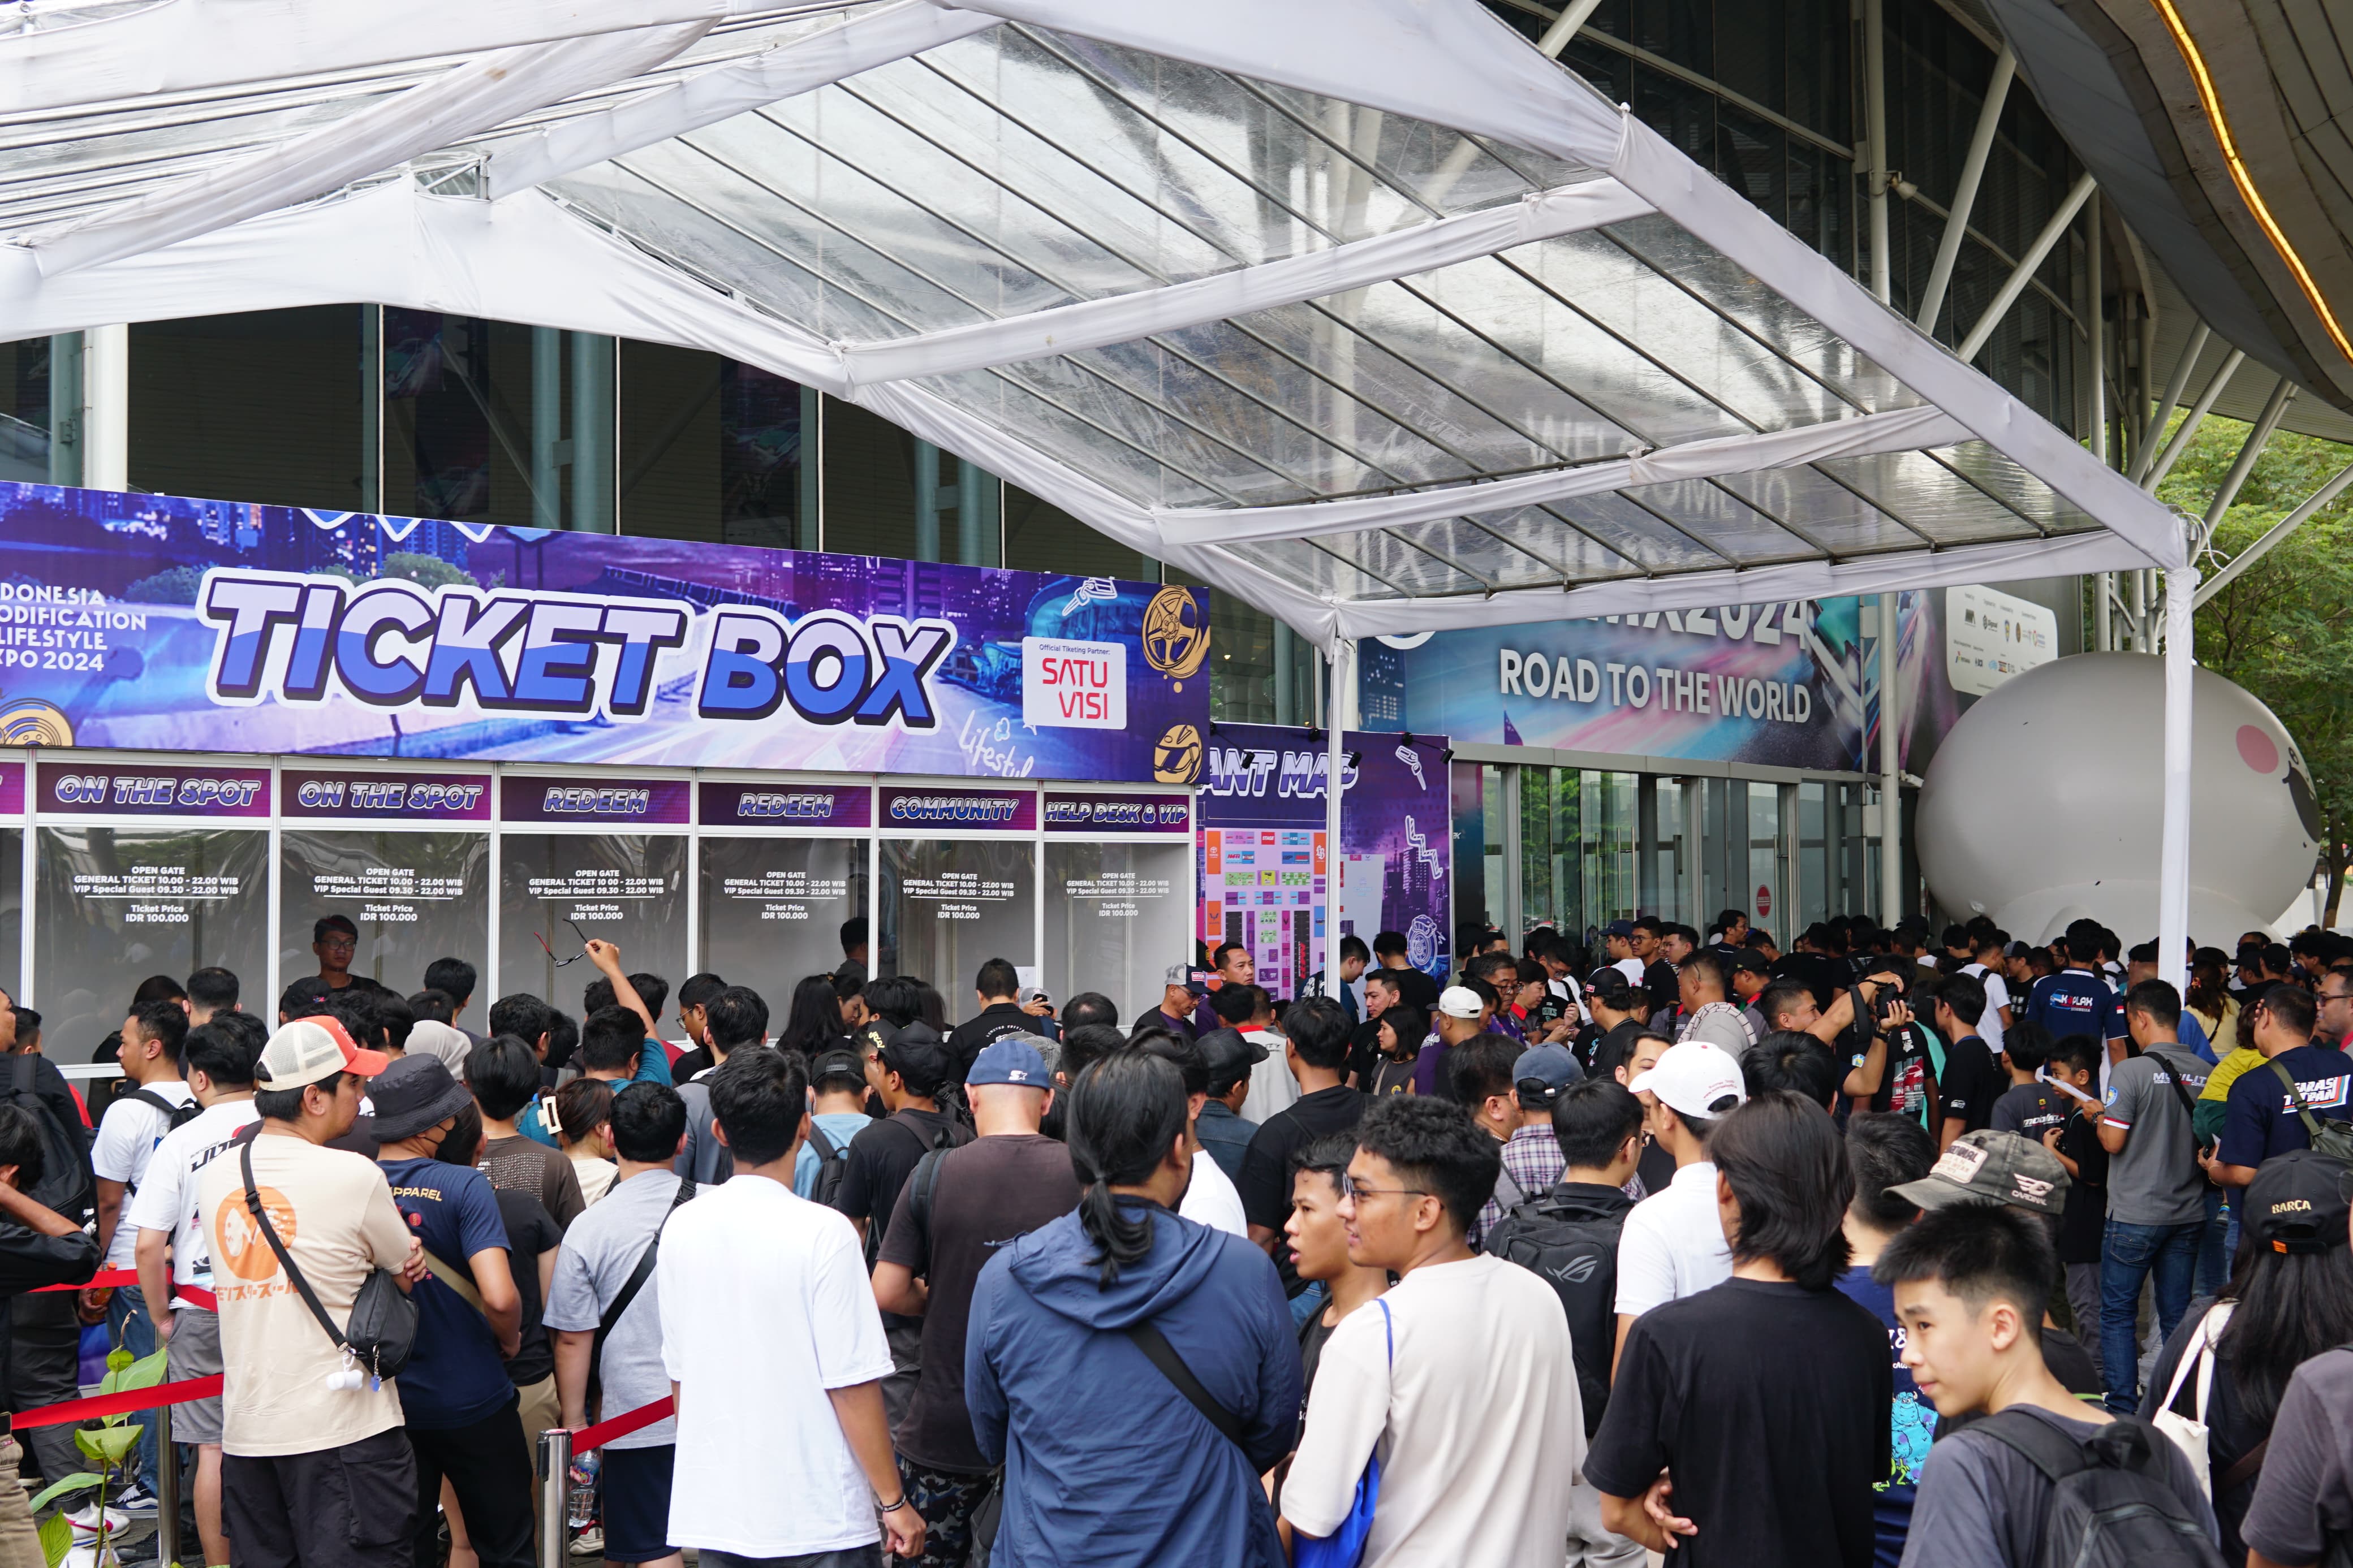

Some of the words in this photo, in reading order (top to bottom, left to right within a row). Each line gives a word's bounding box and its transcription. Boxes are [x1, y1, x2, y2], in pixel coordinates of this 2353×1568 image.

[204, 574, 689, 717] TICKET
[698, 611, 951, 729] BOX
[1039, 643, 1061, 653] Official
[1062, 645, 1086, 655] Tiketing
[1087, 646, 1110, 656] Partner:
[42, 650, 105, 672] 2024
[1042, 657, 1107, 688] SATU
[1499, 648, 1600, 705] ROAD
[1606, 662, 1650, 710] TO
[1655, 668, 1711, 715] THE
[1717, 676, 1811, 724] WORLD
[1058, 690, 1108, 720] VISI
[56, 775, 109, 804] ON
[113, 777, 177, 805] THE
[178, 778, 261, 807] SPOT
[298, 780, 346, 807] ON
[350, 781, 407, 809] THE
[407, 783, 484, 810] SPOT
[543, 787, 649, 813] REDEEM
[737, 793, 835, 818] REDEEM
[890, 796, 1019, 820] COMMUNITY
[1044, 802, 1092, 822] HELP
[1092, 802, 1143, 823] DESK
[1141, 804, 1156, 824] &
[1158, 804, 1189, 824] VIP
[92, 885, 126, 895] Special
[330, 885, 361, 895] Special
[544, 887, 571, 896] Special
[126, 914, 144, 922] IDR
[146, 914, 188, 922] 100.000
[389, 1186, 443, 1202] PPAREL
[2011, 1189, 2048, 1206] CARDINAL
[2271, 1199, 2312, 1214] BARÇA
